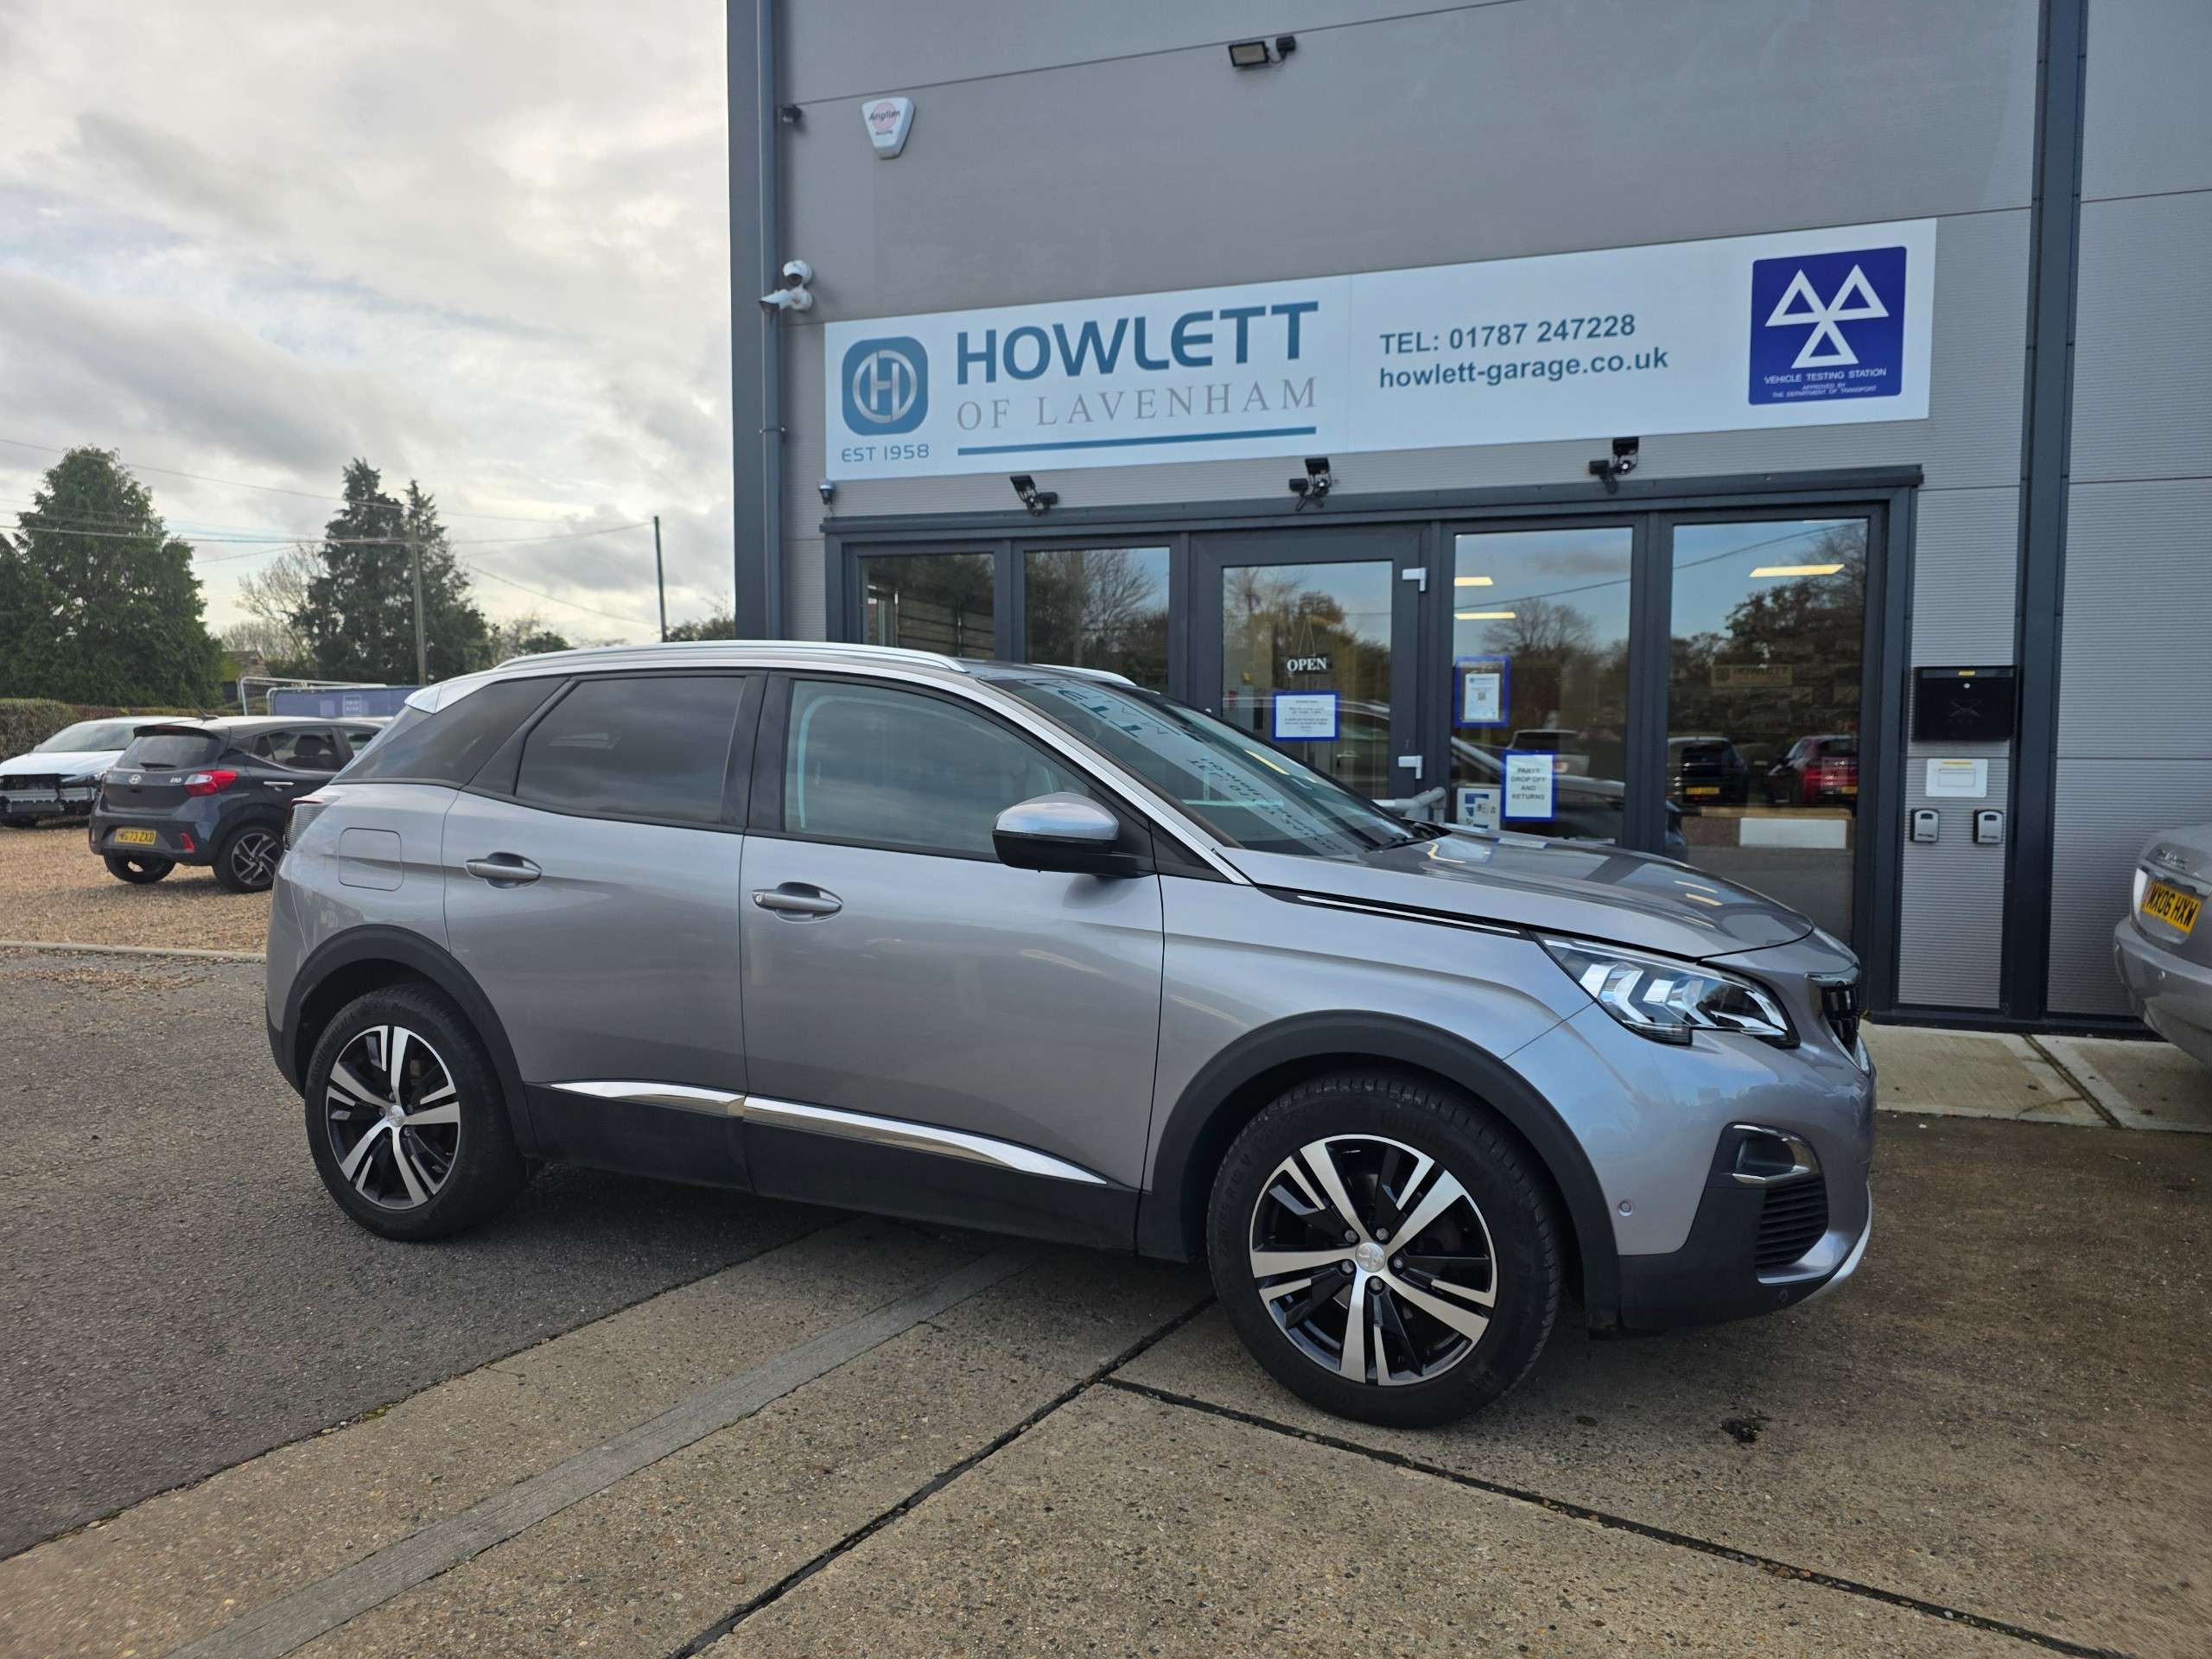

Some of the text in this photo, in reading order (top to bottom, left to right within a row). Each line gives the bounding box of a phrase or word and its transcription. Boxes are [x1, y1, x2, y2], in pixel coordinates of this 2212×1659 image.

[957, 301, 1319, 385] HOWLETT
[1380, 315, 1636, 355] TEL: 01787 247228
[1379, 346, 1669, 388] howlett-garage.co.uk
[1764, 367, 1886, 385] VEHICLE TESTING STATION
[957, 377, 1317, 430] OF LAVENHAM
[842, 443, 930, 463] EST 1958
[1287, 658, 1327, 671] OPEN
